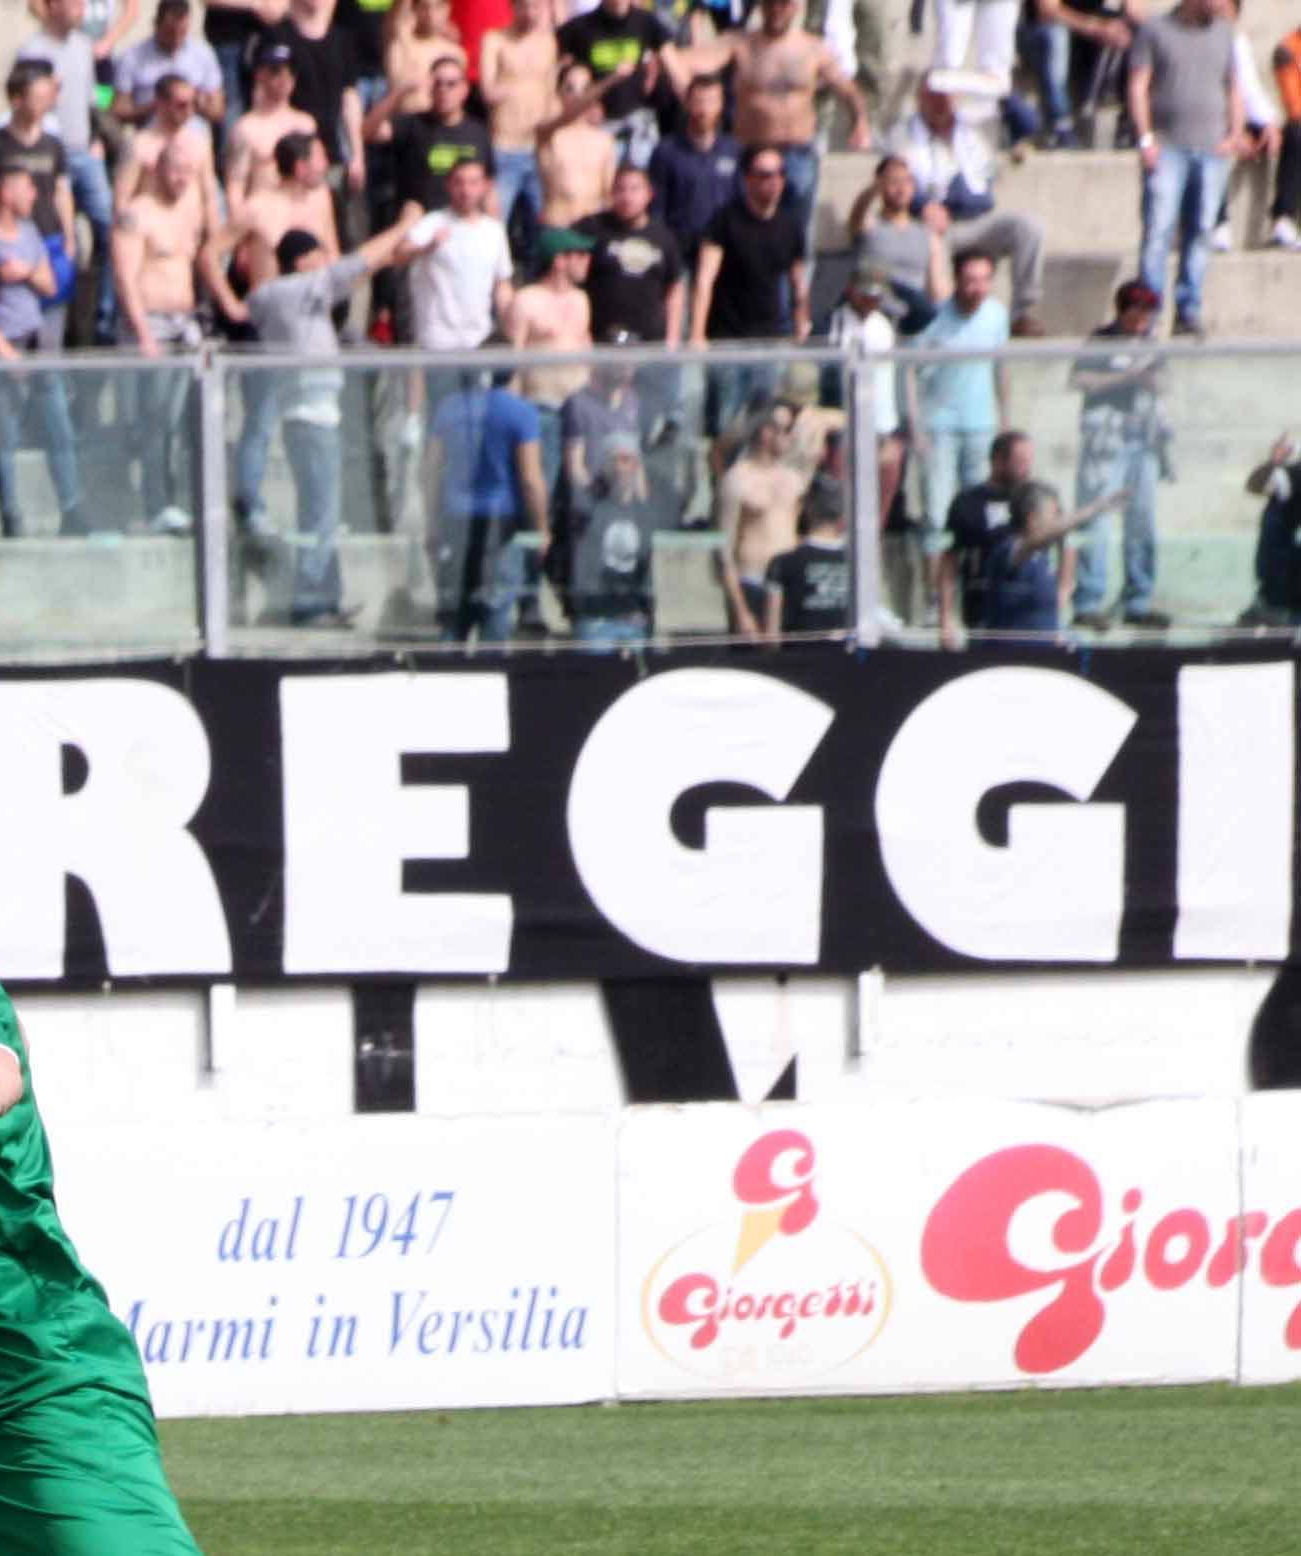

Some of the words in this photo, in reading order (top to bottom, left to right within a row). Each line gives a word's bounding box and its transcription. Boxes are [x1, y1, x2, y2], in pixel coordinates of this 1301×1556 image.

[217, 1195, 305, 1263] dal
[335, 1190, 455, 1260] 1947
[306, 1298, 358, 1361] in
[388, 1287, 589, 1357] Versilia
[658, 1272, 878, 1351] Giorgetti
